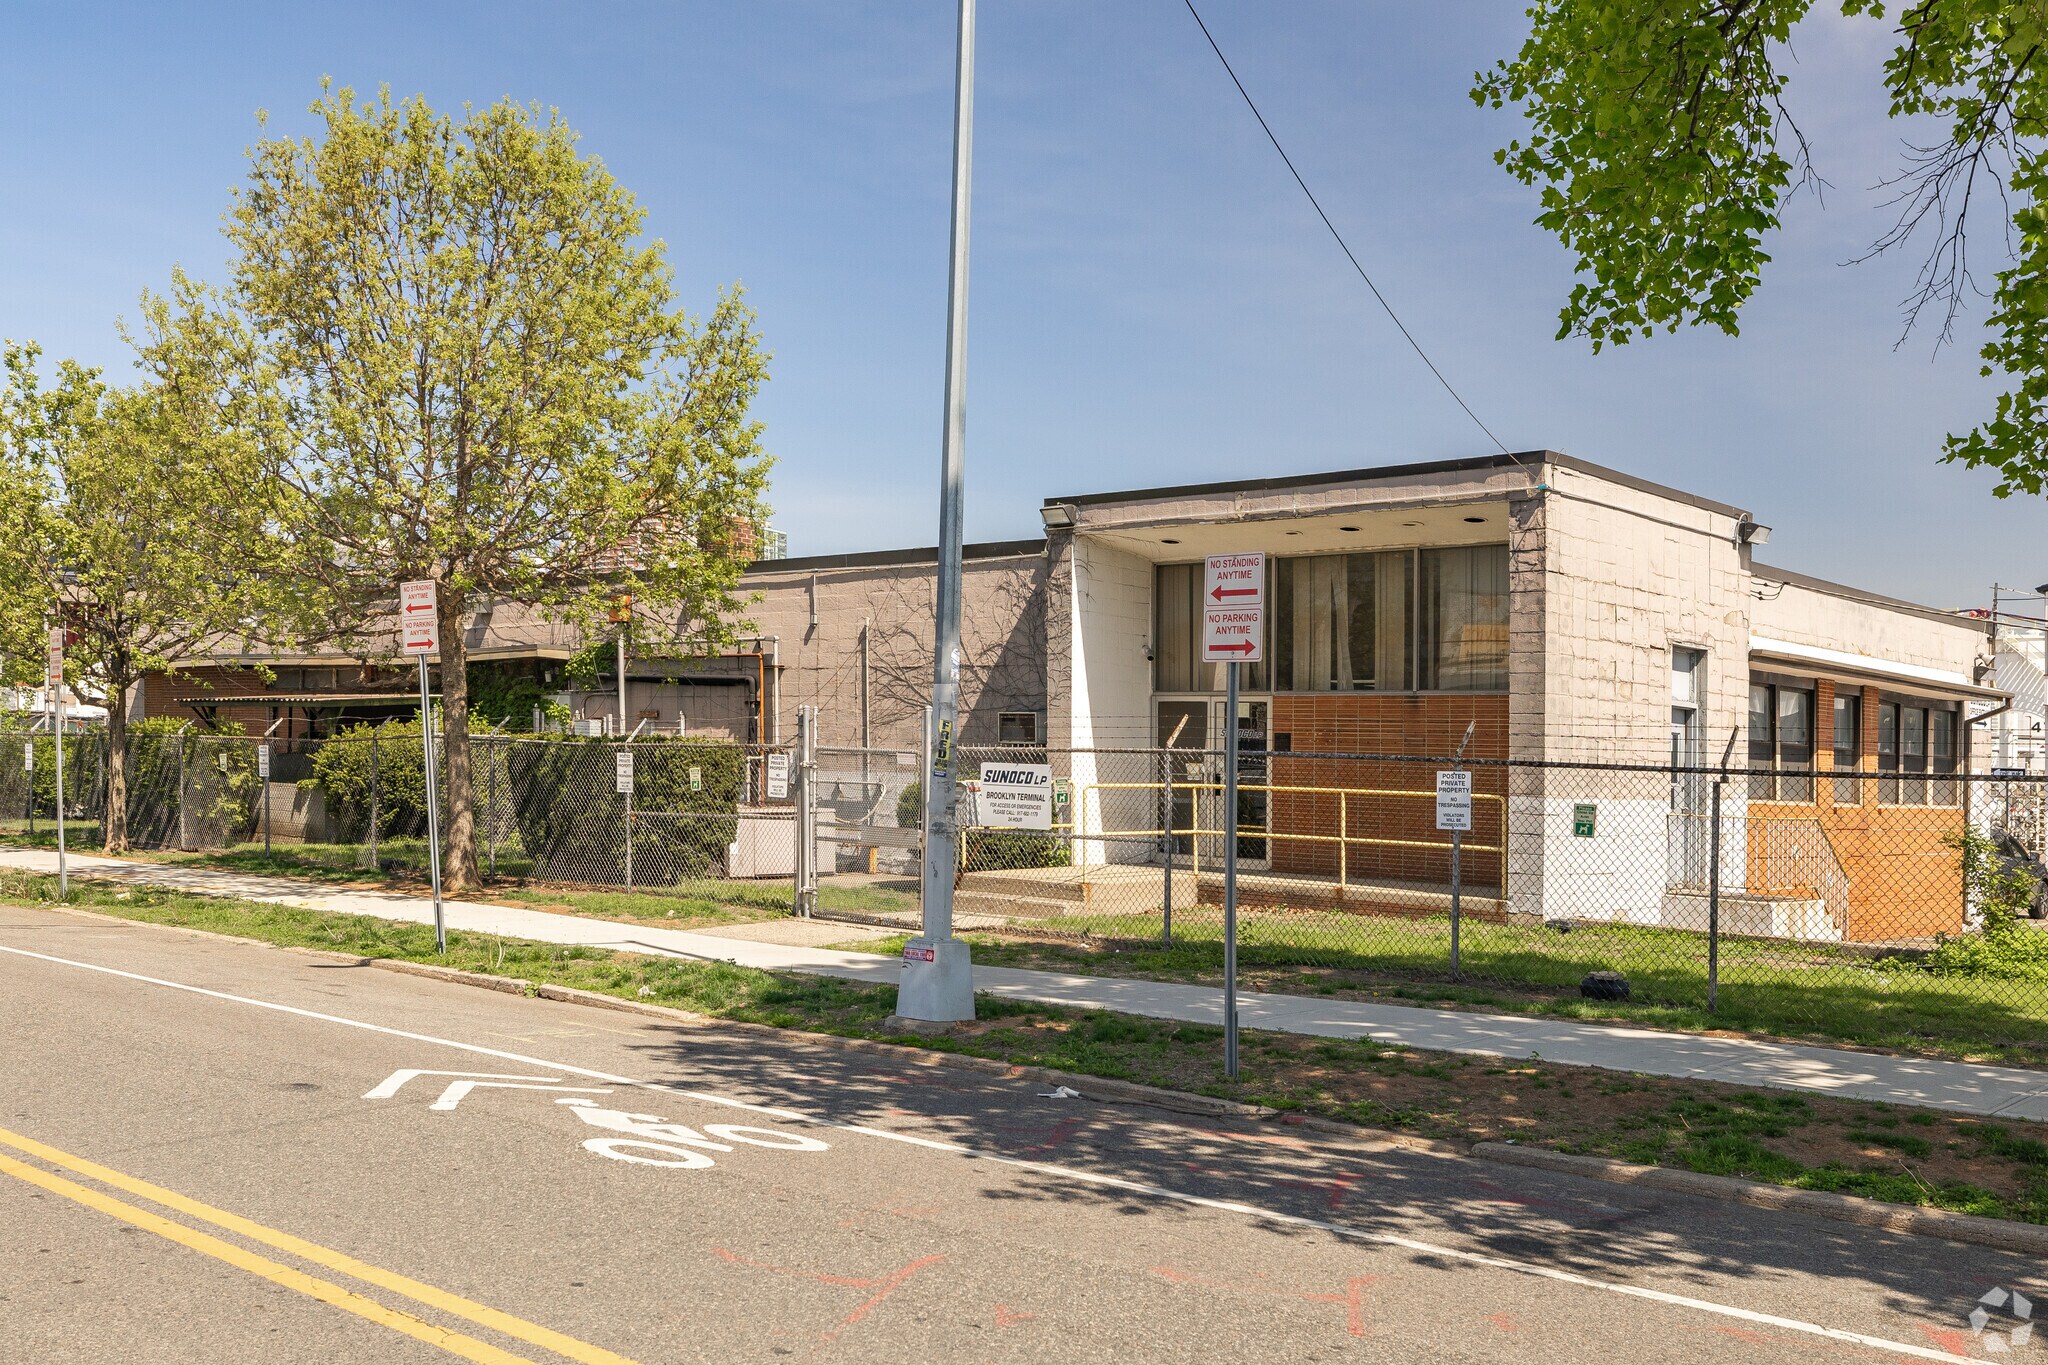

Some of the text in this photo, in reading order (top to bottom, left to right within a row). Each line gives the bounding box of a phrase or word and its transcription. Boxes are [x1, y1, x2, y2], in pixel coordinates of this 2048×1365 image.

[1210, 558, 1260, 569] NO STANDING
[1216, 570, 1252, 580] ANYTIME
[411, 584, 432, 592] STANDING
[1208, 613, 1258, 623] NO PARKING
[1216, 626, 1250, 634] ANYTIME
[984, 770, 1048, 785] SUNOCO LP
[986, 791, 1046, 802] BROOKLYN TERMINAL
